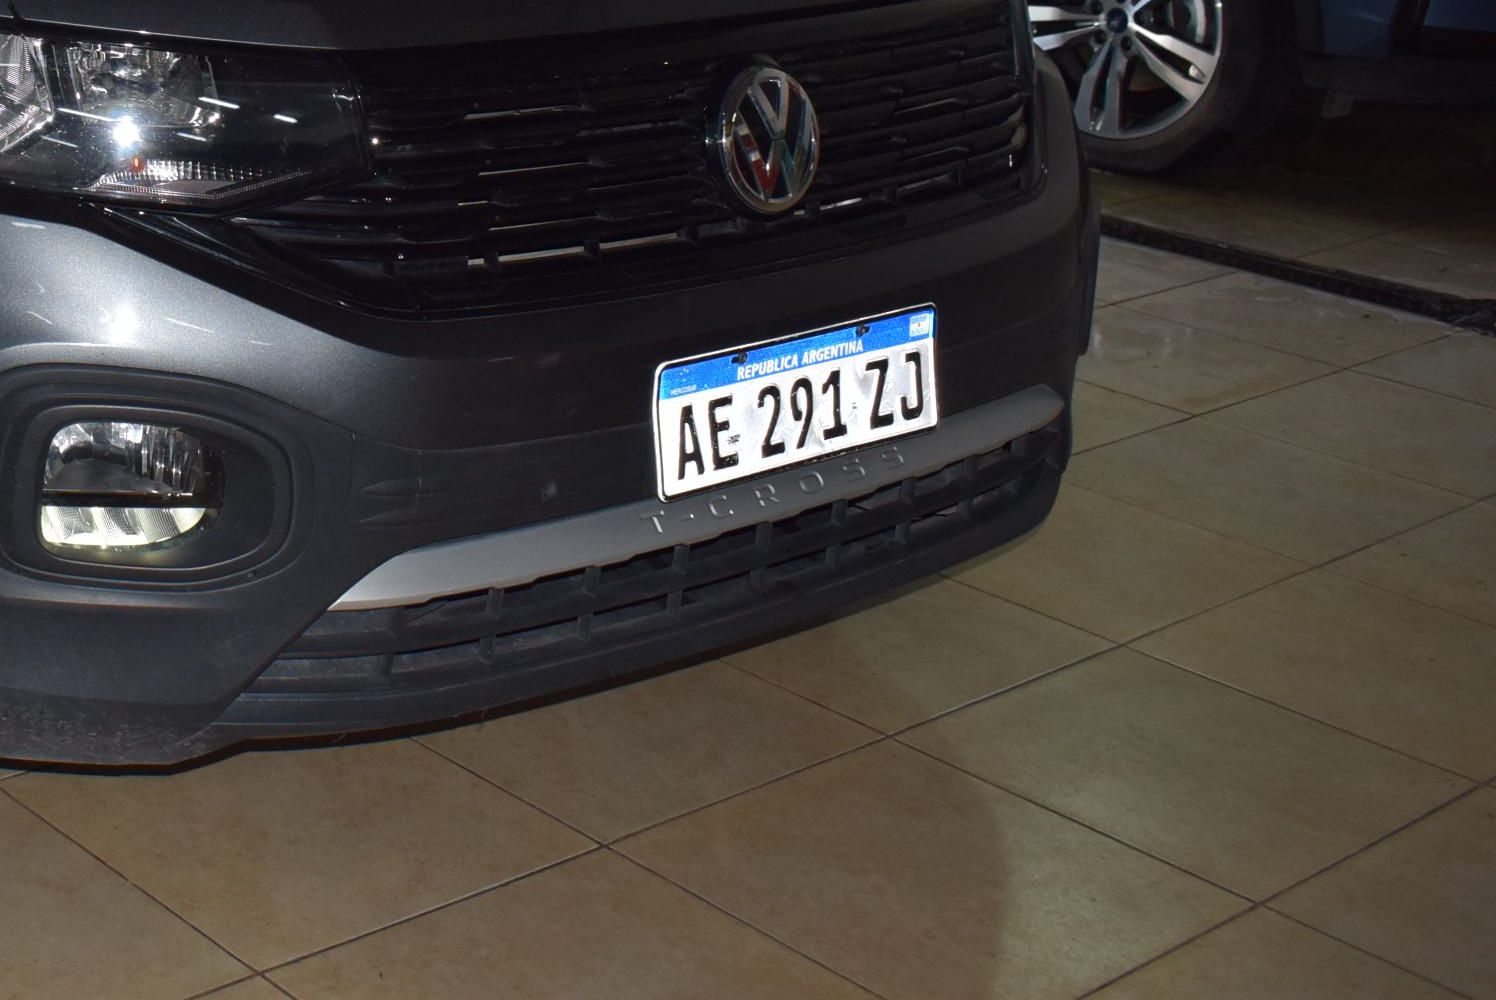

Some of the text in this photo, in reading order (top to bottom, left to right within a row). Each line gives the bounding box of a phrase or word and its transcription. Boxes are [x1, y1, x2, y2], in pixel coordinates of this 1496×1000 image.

[670, 384, 697, 396] MERCOSUR
[737, 339, 863, 380] REPUBLICA ARGENTINA
[678, 351, 924, 480] AE 291 ZJ
[641, 446, 904, 534] T-CROSS
